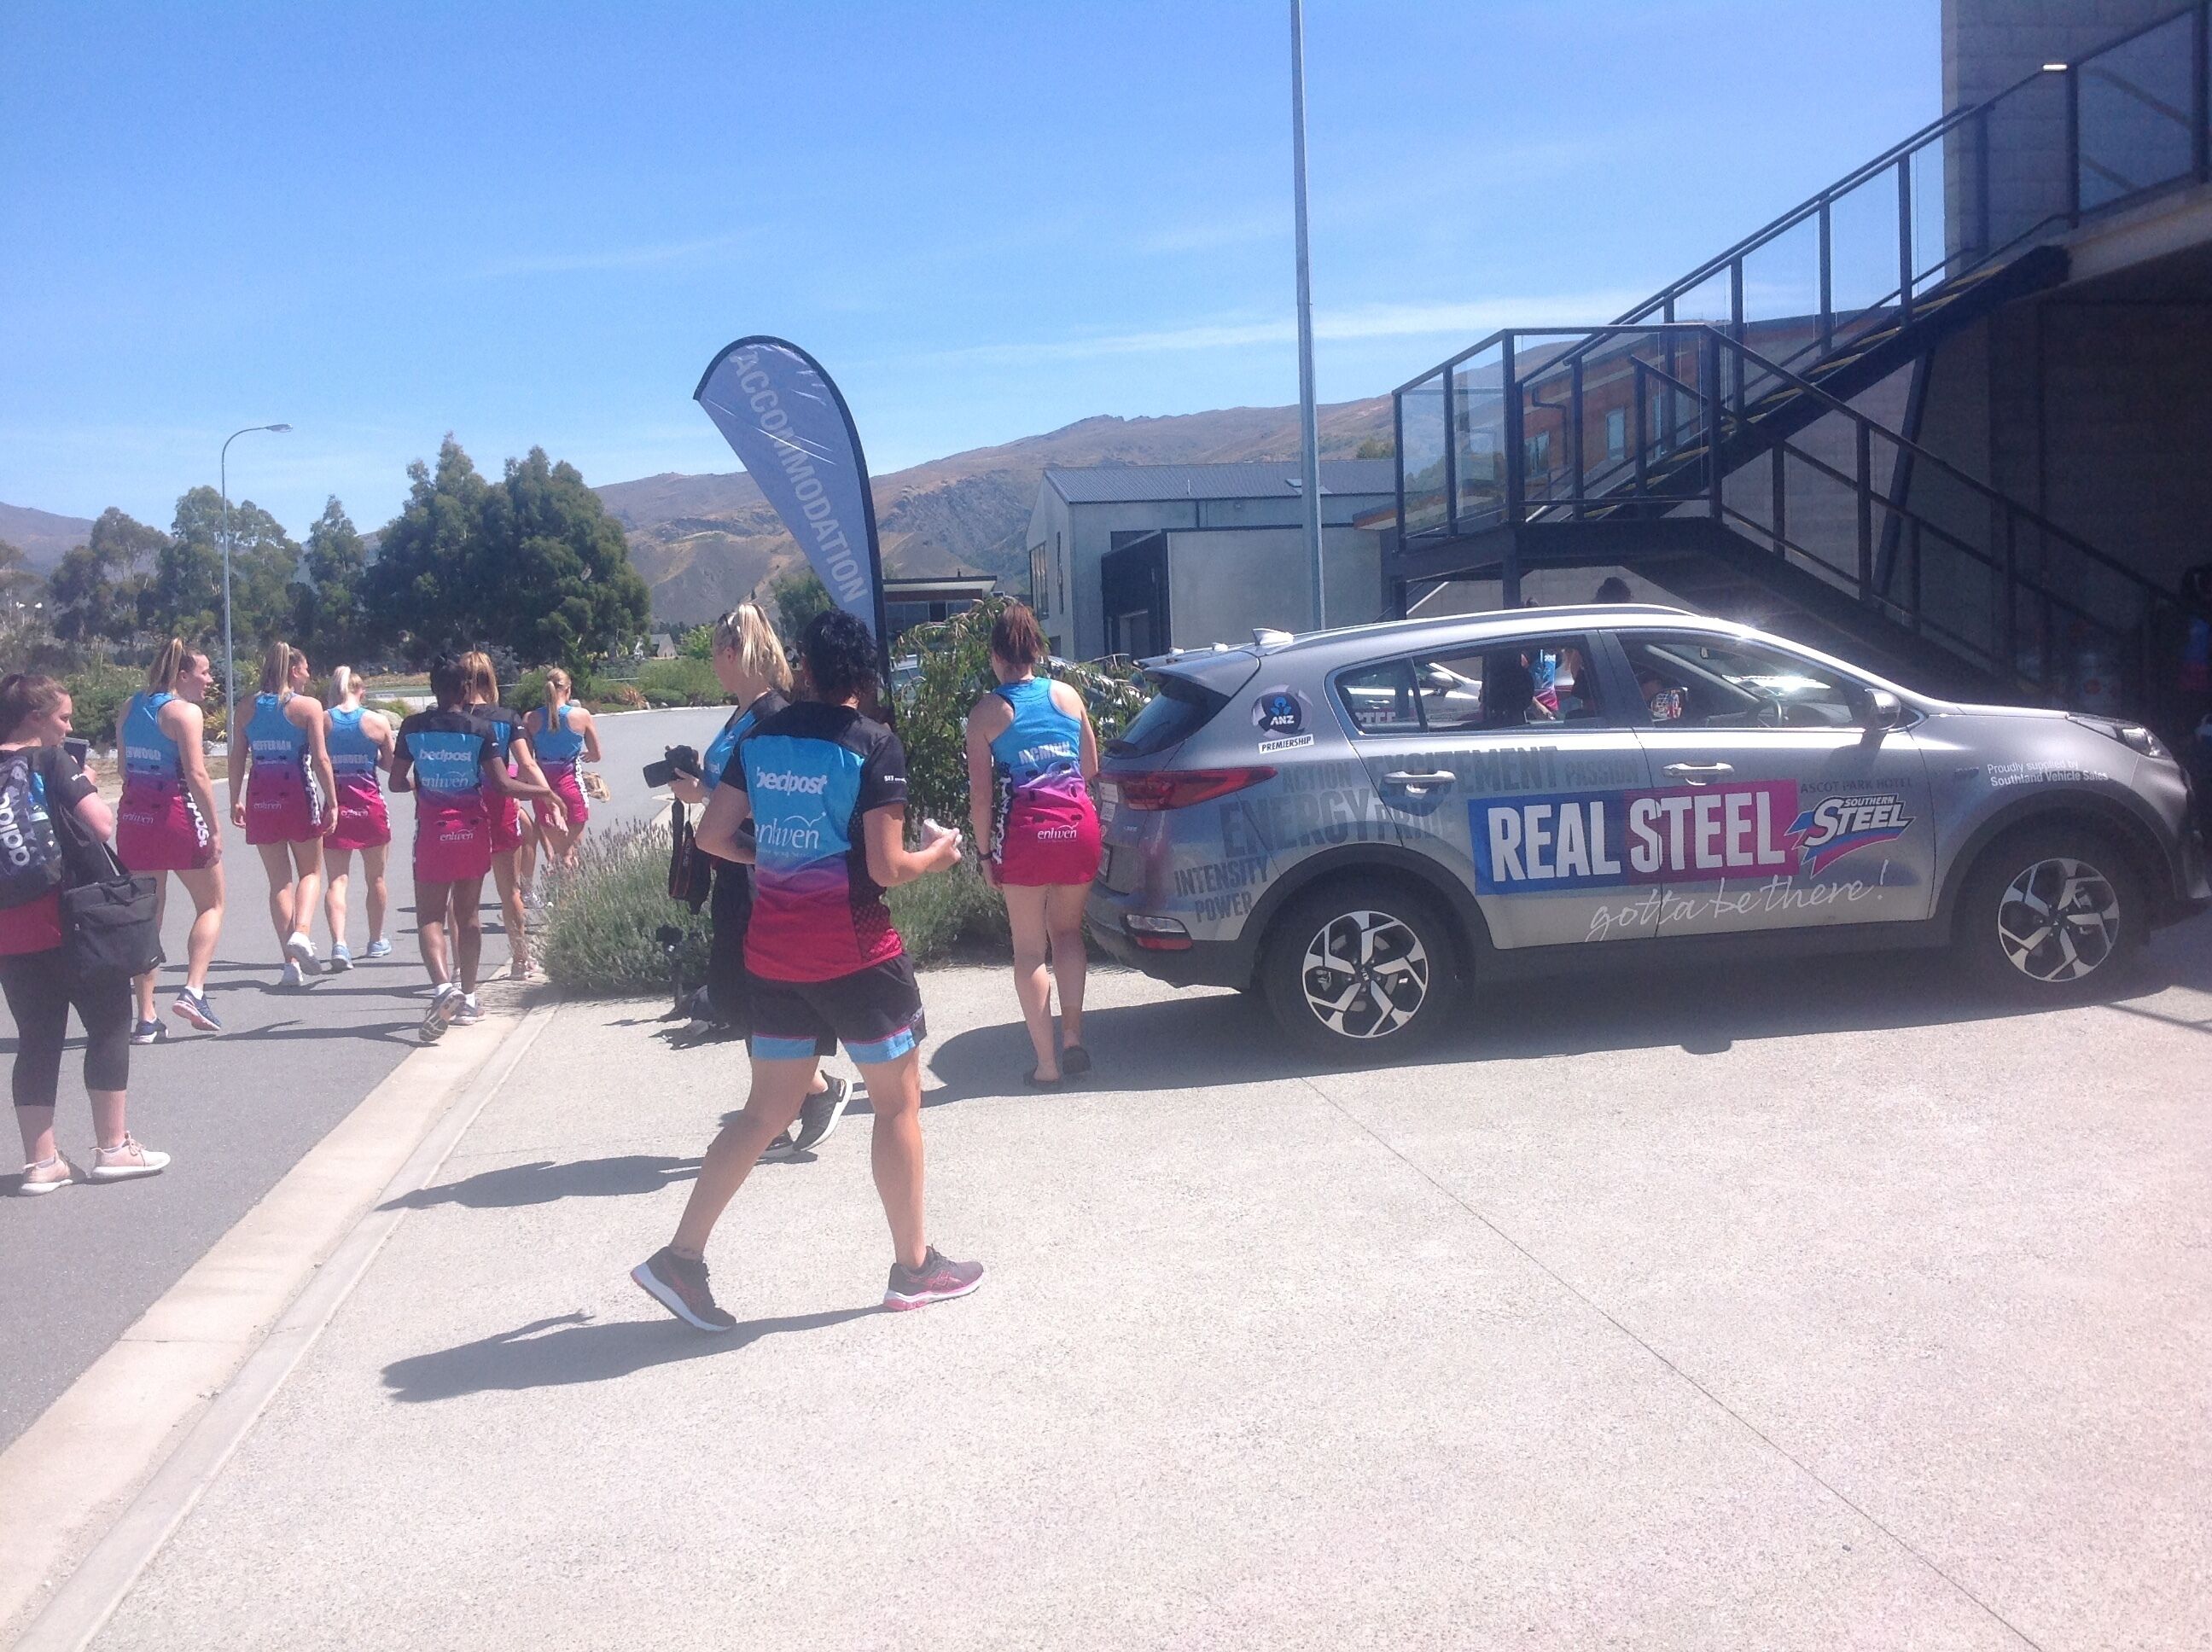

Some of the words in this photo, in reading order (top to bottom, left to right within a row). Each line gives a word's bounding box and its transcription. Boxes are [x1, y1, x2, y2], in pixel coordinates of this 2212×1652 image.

[729, 351, 869, 602] ACCOMMODATION
[1269, 714, 1295, 726] ANZ
[1260, 735, 1313, 753] PREMIERSHIP
[419, 748, 471, 762] bedpost
[1988, 762, 2023, 775] Proudly
[2026, 759, 2065, 771] supplied
[2068, 759, 2079, 770] by
[421, 771, 469, 788] enliven
[756, 766, 828, 796] bedpost
[1991, 771, 2043, 787] Southland
[2046, 770, 2081, 782] Vehicle
[2082, 770, 2109, 781] Sales
[1801, 782, 1839, 794] ASCOT
[1843, 796, 1895, 807] SOUTHERN
[1218, 788, 1380, 858] ENERGY
[1804, 799, 1910, 846] STEEL
[439, 829, 474, 841] enliven
[1037, 826, 1078, 840] enliven
[1487, 800, 1621, 882] REAL
[1628, 791, 1785, 874] STEEL
[1174, 857, 1268, 897] INTENSITY
[1195, 892, 1253, 922] POWER
[1585, 887, 1708, 942] gotta
[1709, 877, 1760, 919] be
[1760, 859, 1889, 912] there!
